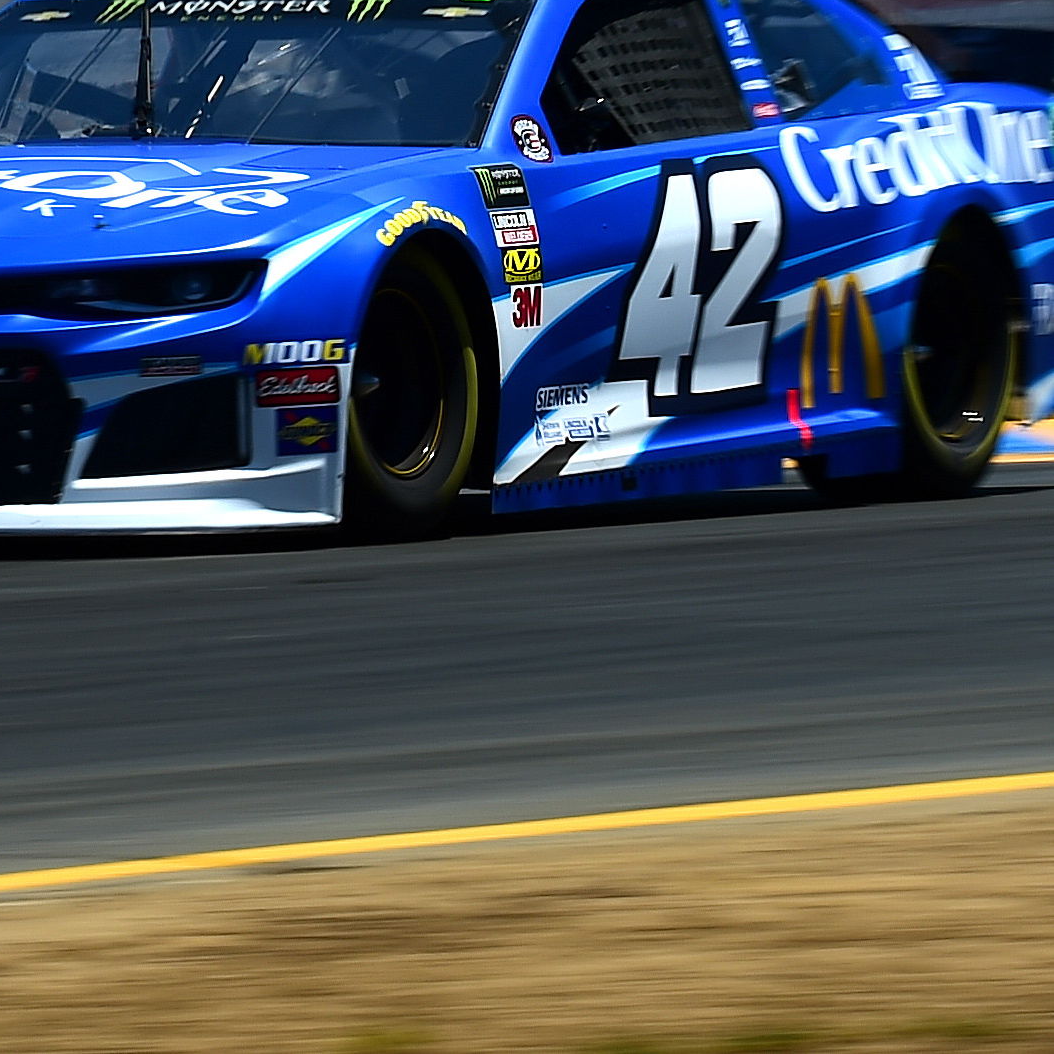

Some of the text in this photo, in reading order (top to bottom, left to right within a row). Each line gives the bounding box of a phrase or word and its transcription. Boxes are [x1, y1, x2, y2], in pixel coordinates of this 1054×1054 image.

[376, 200, 468, 247] GOODYEAR
[618, 167, 783, 397] 42
[512, 286, 542, 328] 3M
[243, 339, 346, 364] MOOG
[536, 386, 589, 409] SIEMENS
